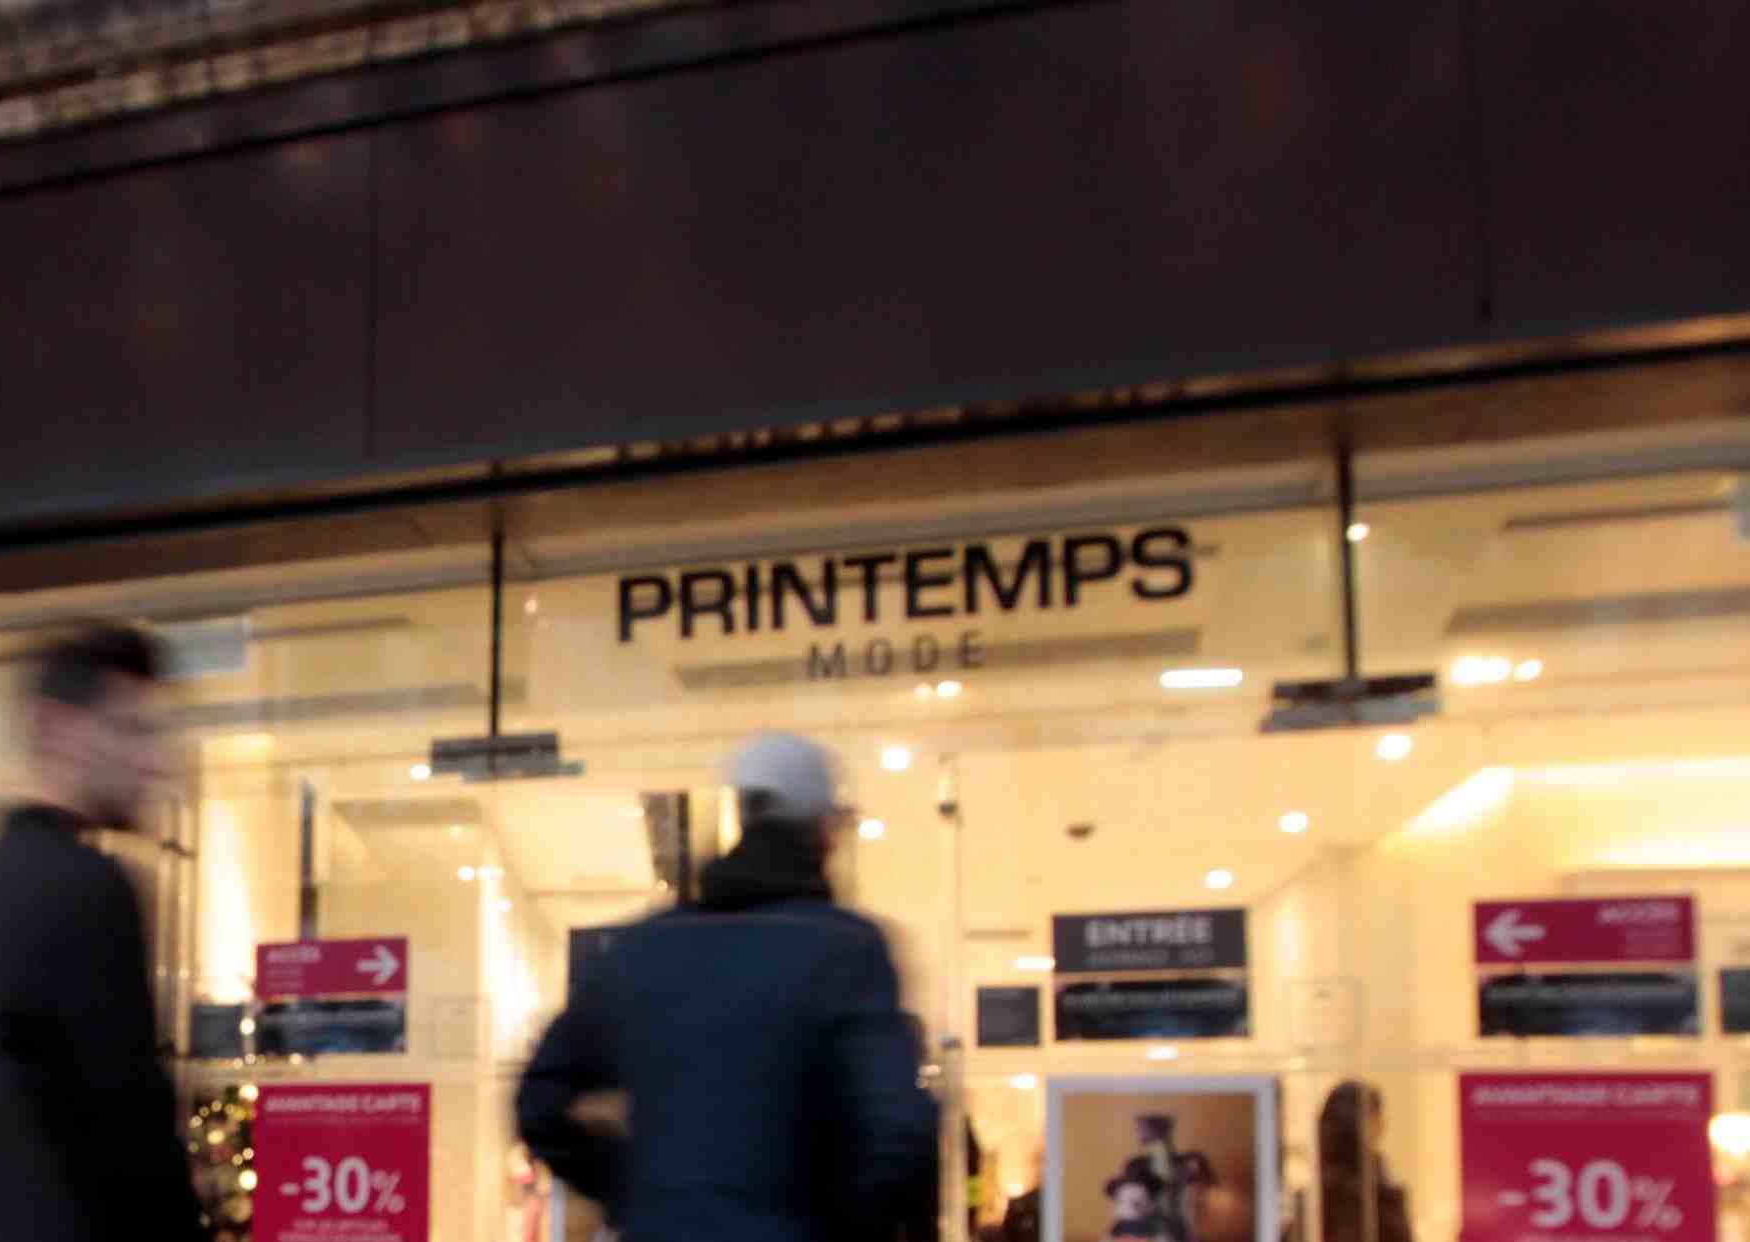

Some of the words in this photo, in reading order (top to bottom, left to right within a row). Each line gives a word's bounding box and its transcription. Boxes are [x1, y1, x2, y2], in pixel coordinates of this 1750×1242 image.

[616, 527, 1194, 643] PRINTEMPS
[807, 631, 986, 681] MODE
[1084, 914, 1214, 947] ENTRÉE
[278, 1155, 407, 1214] -30%
[1497, 1158, 1683, 1229] -30%
